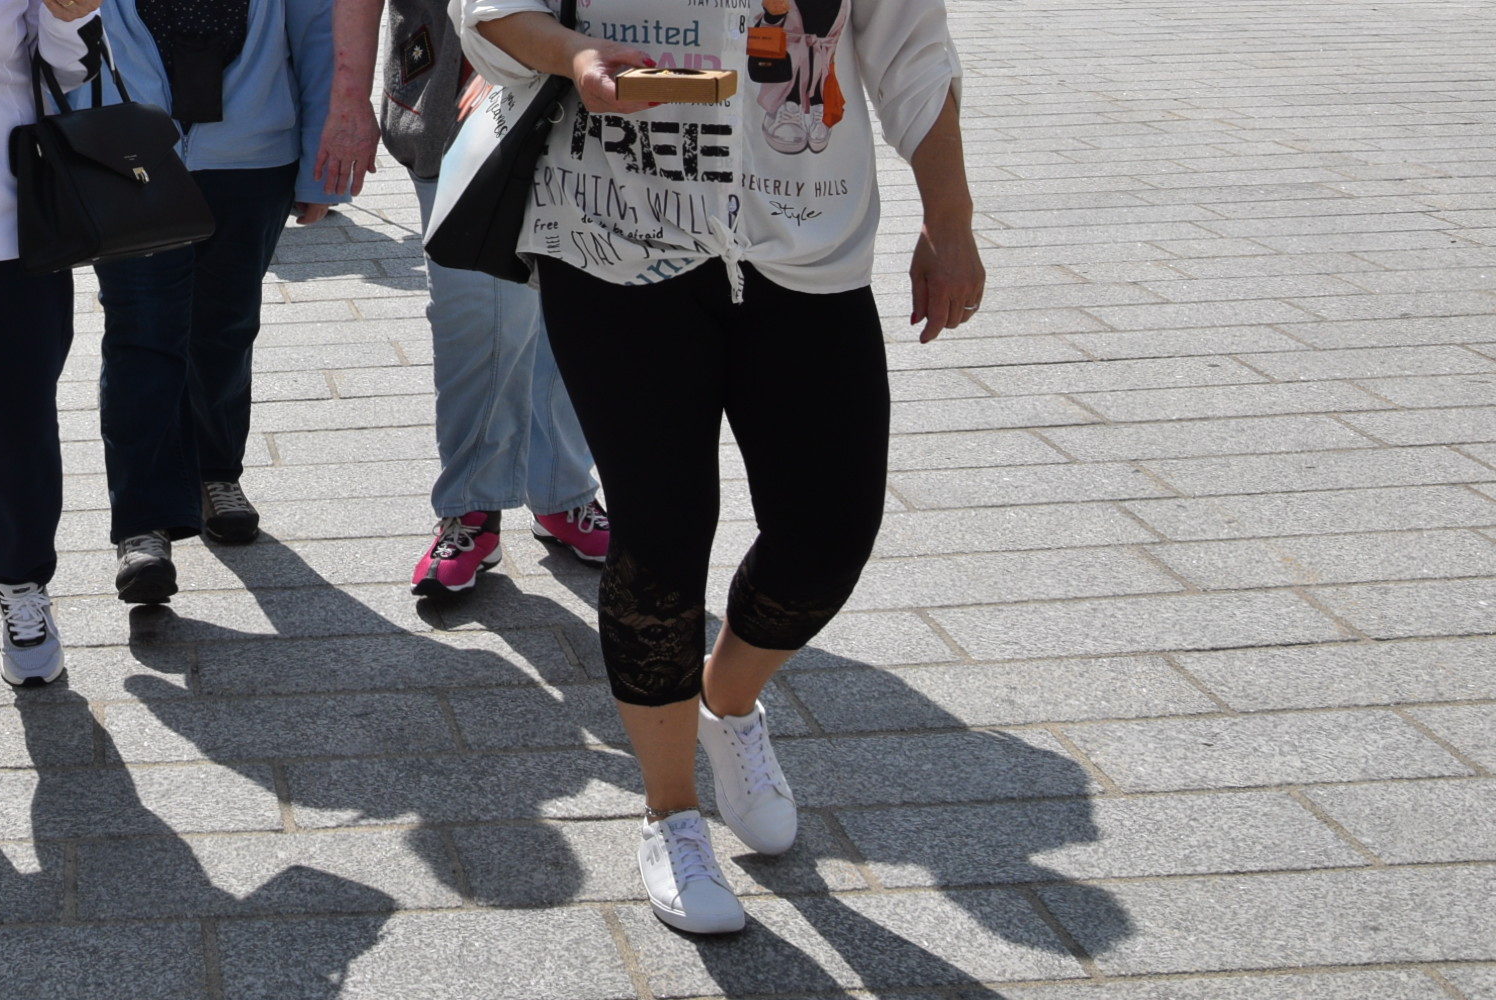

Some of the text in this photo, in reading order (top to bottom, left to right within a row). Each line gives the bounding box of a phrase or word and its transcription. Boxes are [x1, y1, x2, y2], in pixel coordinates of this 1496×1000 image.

[602, 19, 701, 47] united
[570, 101, 734, 183] FREE
[815, 179, 849, 198] HILLS
[534, 218, 559, 234] free
[769, 201, 823, 227] Style
[613, 222, 624, 236] be
[627, 226, 664, 240] afraid
[570, 230, 623, 269] STAY
